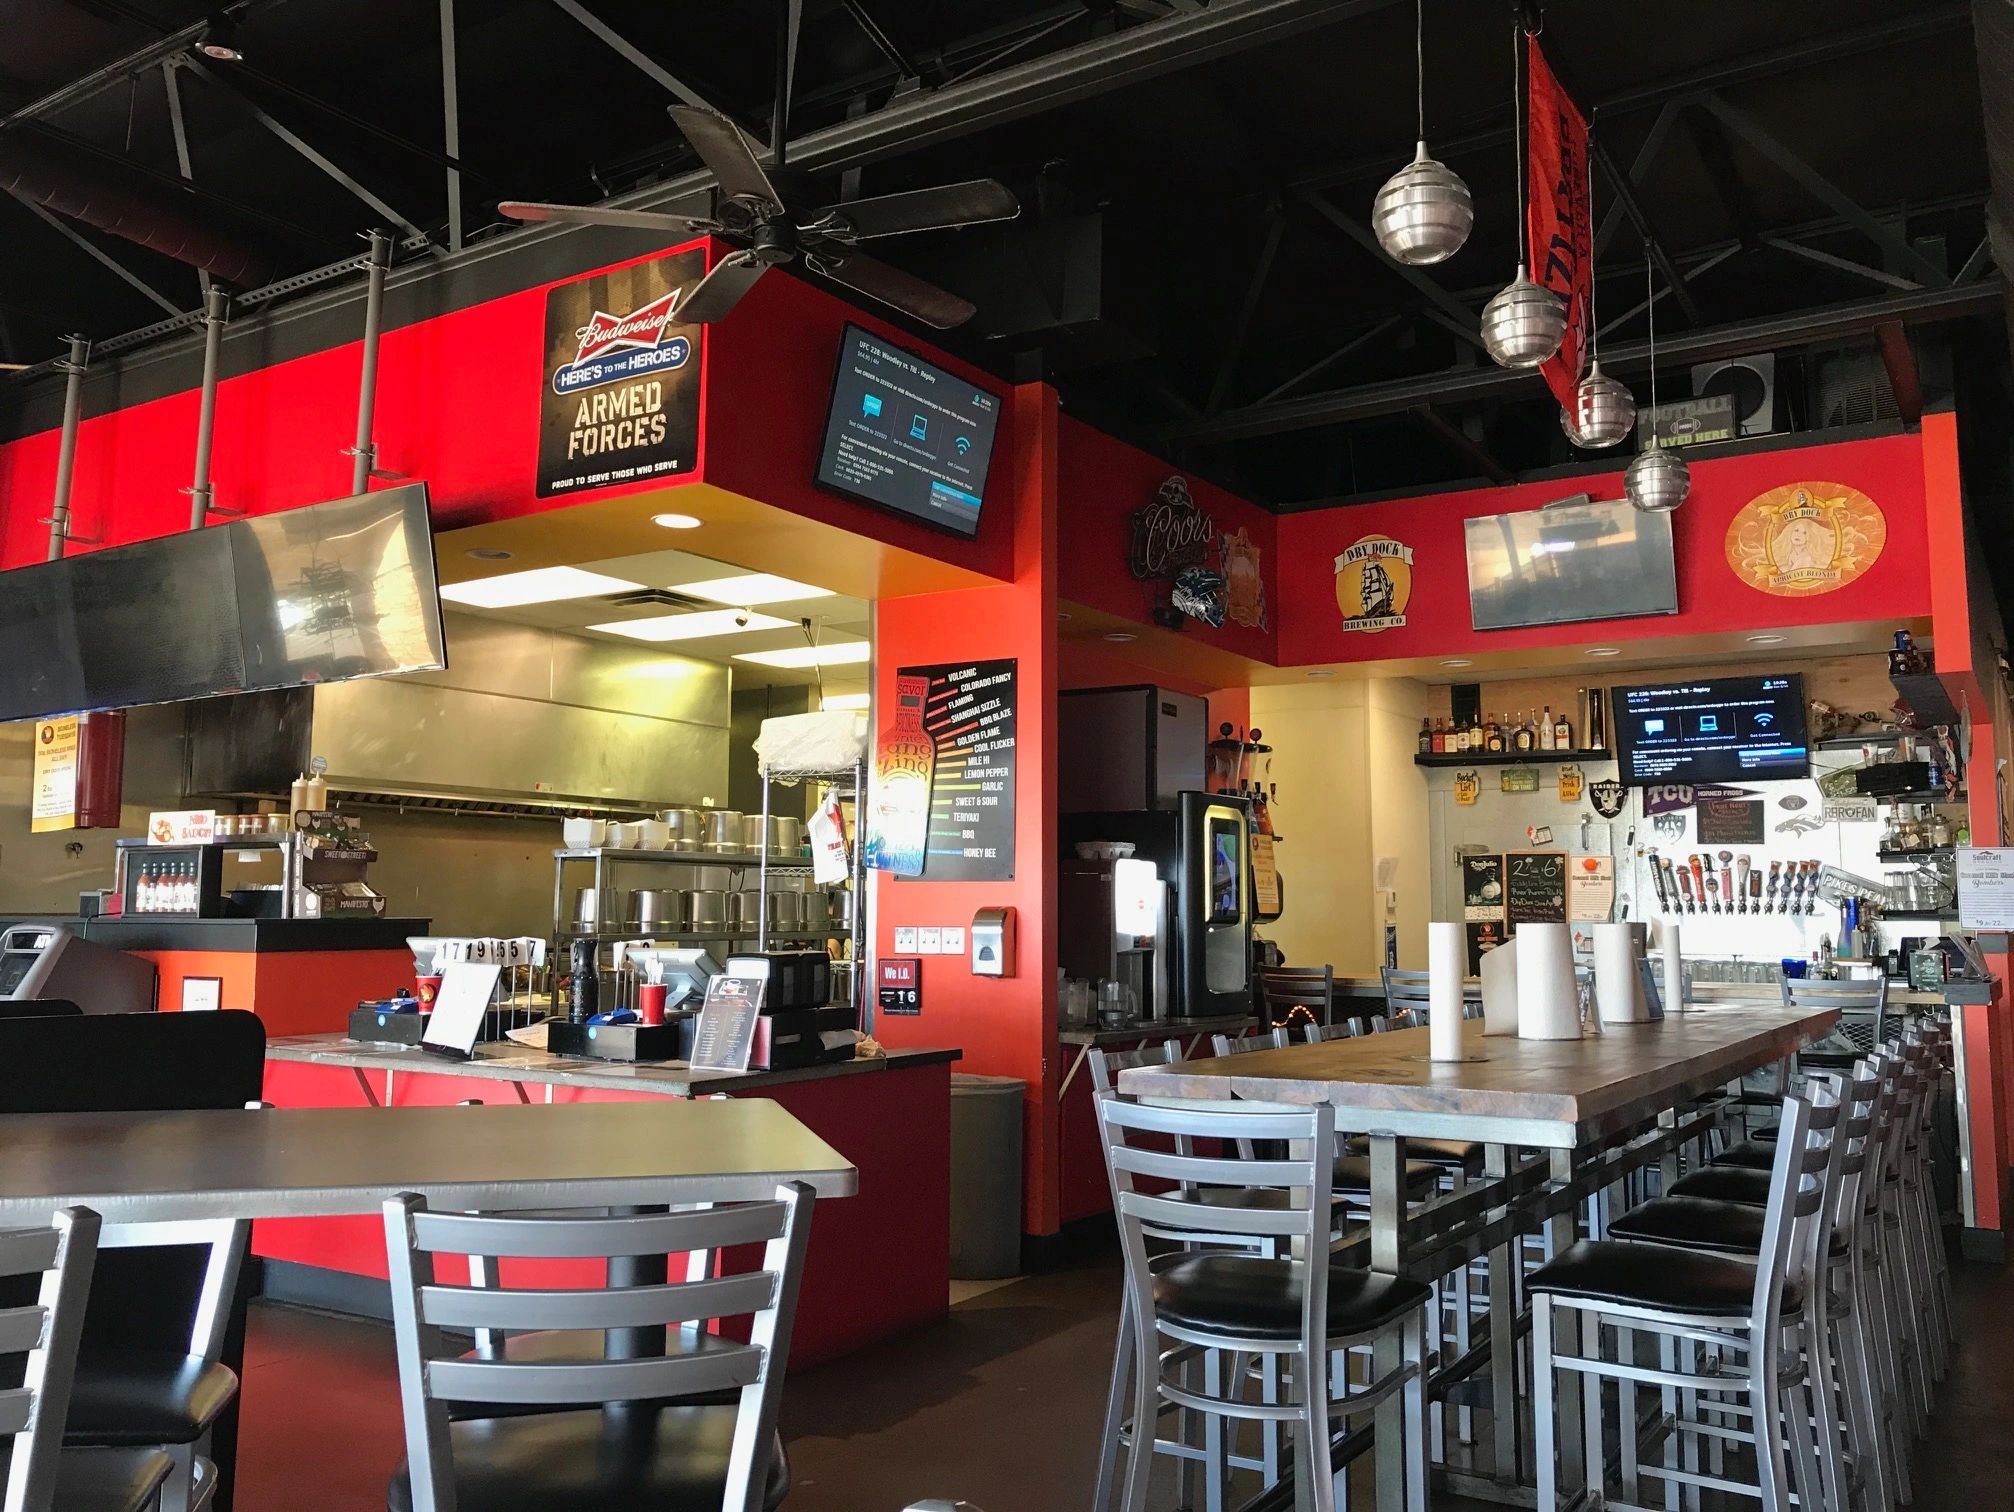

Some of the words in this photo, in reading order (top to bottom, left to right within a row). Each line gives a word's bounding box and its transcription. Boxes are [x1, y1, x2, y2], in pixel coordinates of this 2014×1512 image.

[575, 312, 672, 349] Budweiser
[561, 365, 602, 387] HERE'S
[604, 365, 613, 374] TO
[614, 361, 627, 371] THE
[628, 346, 681, 370] HEROES
[858, 340, 869, 353] UFC
[881, 351, 902, 368] Woodley
[920, 369, 935, 384] Replay
[575, 381, 662, 428] ARMED
[568, 413, 667, 460] FORCES
[1644, 434, 1693, 449] SRVED
[552, 478, 575, 490] PROUD
[576, 476, 586, 486] TO
[587, 472, 610, 483] SERVE
[612, 468, 635, 479] THOSE
[636, 465, 652, 476] WHO
[654, 460, 678, 472] SERVE
[1783, 510, 1799, 520] DRY
[1146, 505, 1216, 572] Coors
[1346, 544, 1368, 561] DRY
[1372, 542, 1400, 556] DOCK
[1344, 619, 1384, 630] BREWING
[948, 667, 977, 682] VOLCANIC
[960, 678, 991, 692] COLORADO
[992, 672, 1012, 687] FANCY
[948, 694, 974, 709] FLAMING
[951, 706, 980, 723] SHANGHAI
[980, 698, 1001, 713] SIZZLE
[979, 714, 994, 726] BBQ
[994, 708, 1012, 722] BLAZE
[957, 733, 980, 746] GOLDEN
[980, 727, 1001, 741] FLAME
[974, 742, 990, 753] COOL
[990, 738, 1015, 752] FLICKER
[968, 757, 982, 766] MILE
[983, 756, 990, 765] HI
[964, 770, 985, 779] LEMON
[985, 768, 1008, 777] PEPPER
[982, 781, 1003, 791] GARLIC
[955, 797, 975, 807] SWEET
[982, 797, 998, 806] SOUR
[1648, 784, 1694, 805] TCU
[953, 812, 980, 822] TERIYAKI
[1856, 806, 1875, 818] FAN
[962, 830, 975, 839] BBQ
[963, 848, 983, 858] HONEY
[984, 848, 996, 858] BEE
[1823, 874, 1858, 894] PIKES
[340, 900, 369, 909] MANIFESTO
[466, 940, 486, 960] 19
[884, 966, 897, 979] We
